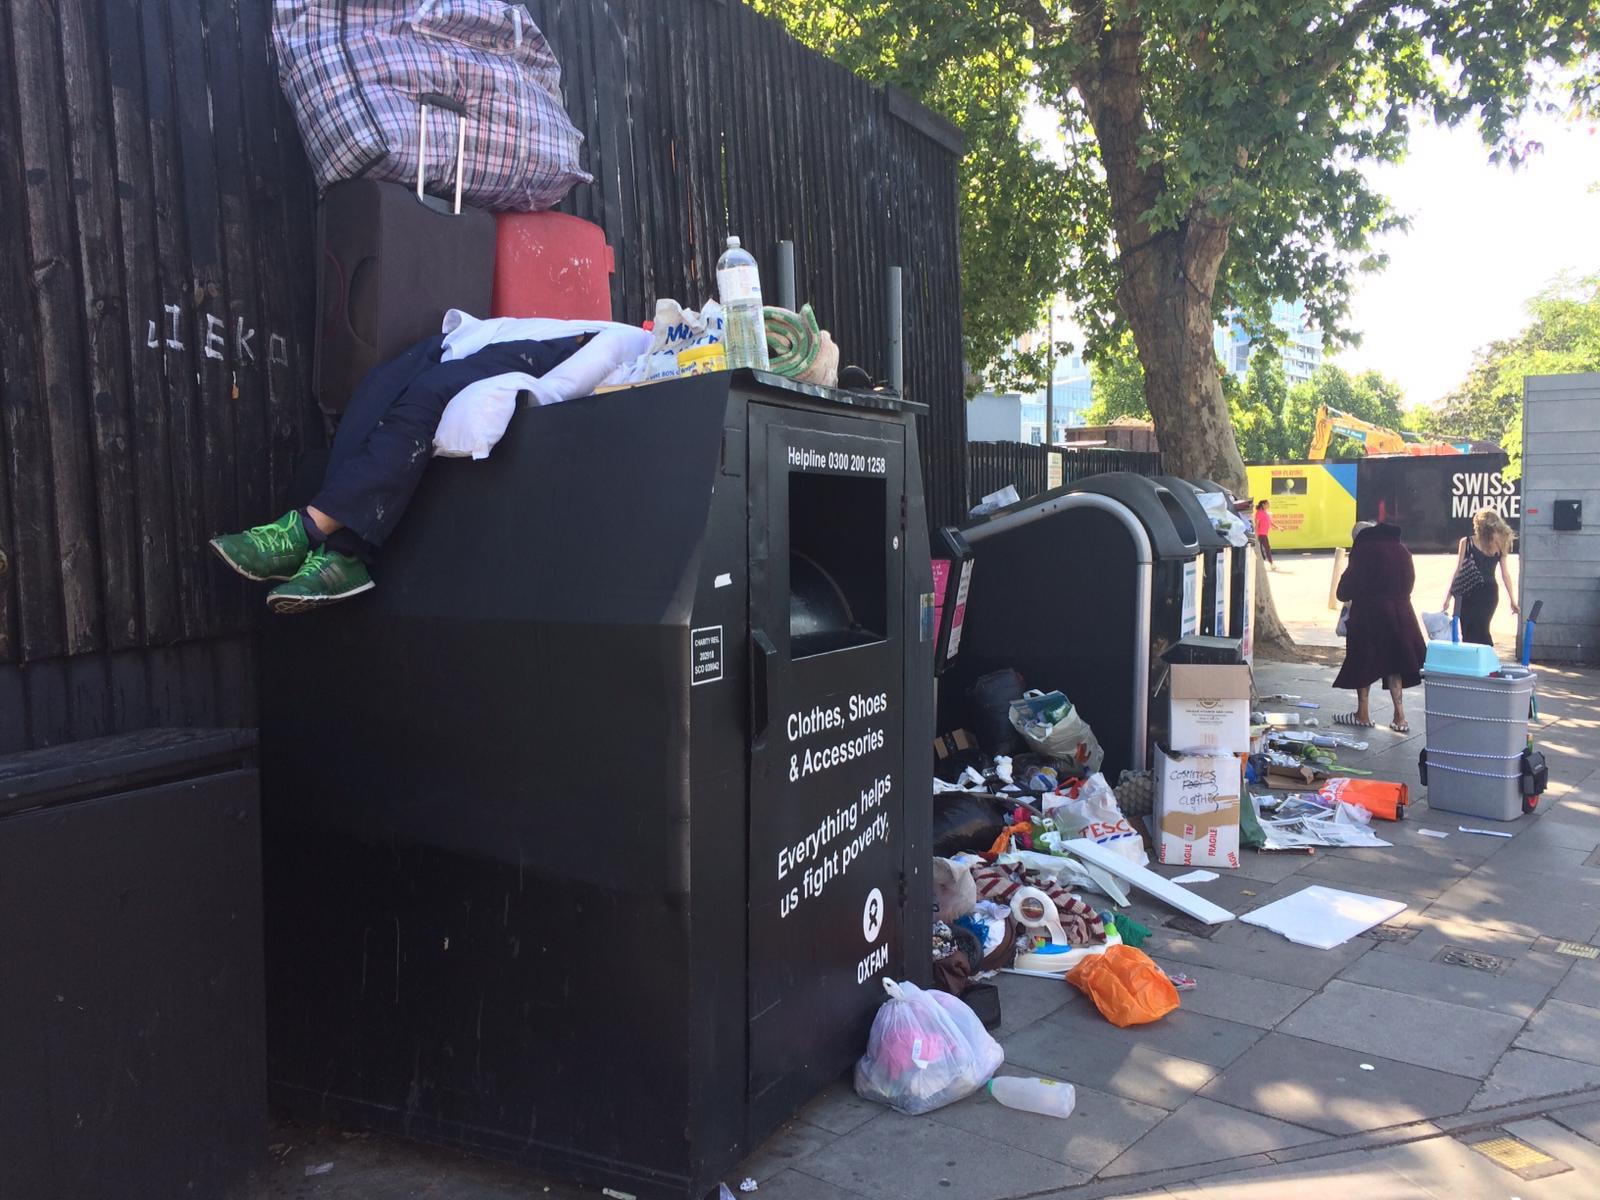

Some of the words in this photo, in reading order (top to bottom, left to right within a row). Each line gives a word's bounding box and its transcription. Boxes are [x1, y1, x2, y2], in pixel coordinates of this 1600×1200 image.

[788, 446, 826, 470] Helpline
[828, 452, 849, 470] 0300
[850, 455, 865, 472] 200
[867, 457, 886, 473] 1258
[1452, 472, 1516, 495] SWISS
[1452, 495, 1521, 518] MARKE
[787, 706, 846, 742] Clothes,
[849, 692, 888, 722] Shoes
[789, 754, 799, 782] &
[801, 728, 884, 777] Accessories
[777, 801, 858, 880] Everything
[861, 774, 891, 815] helps
[1078, 819, 1131, 840] TESC
[780, 887, 798, 918] us
[803, 849, 839, 899] fight
[842, 812, 890, 875] poverty.
[1183, 843, 1193, 866] AGILE
[857, 943, 889, 985] OXFAM
